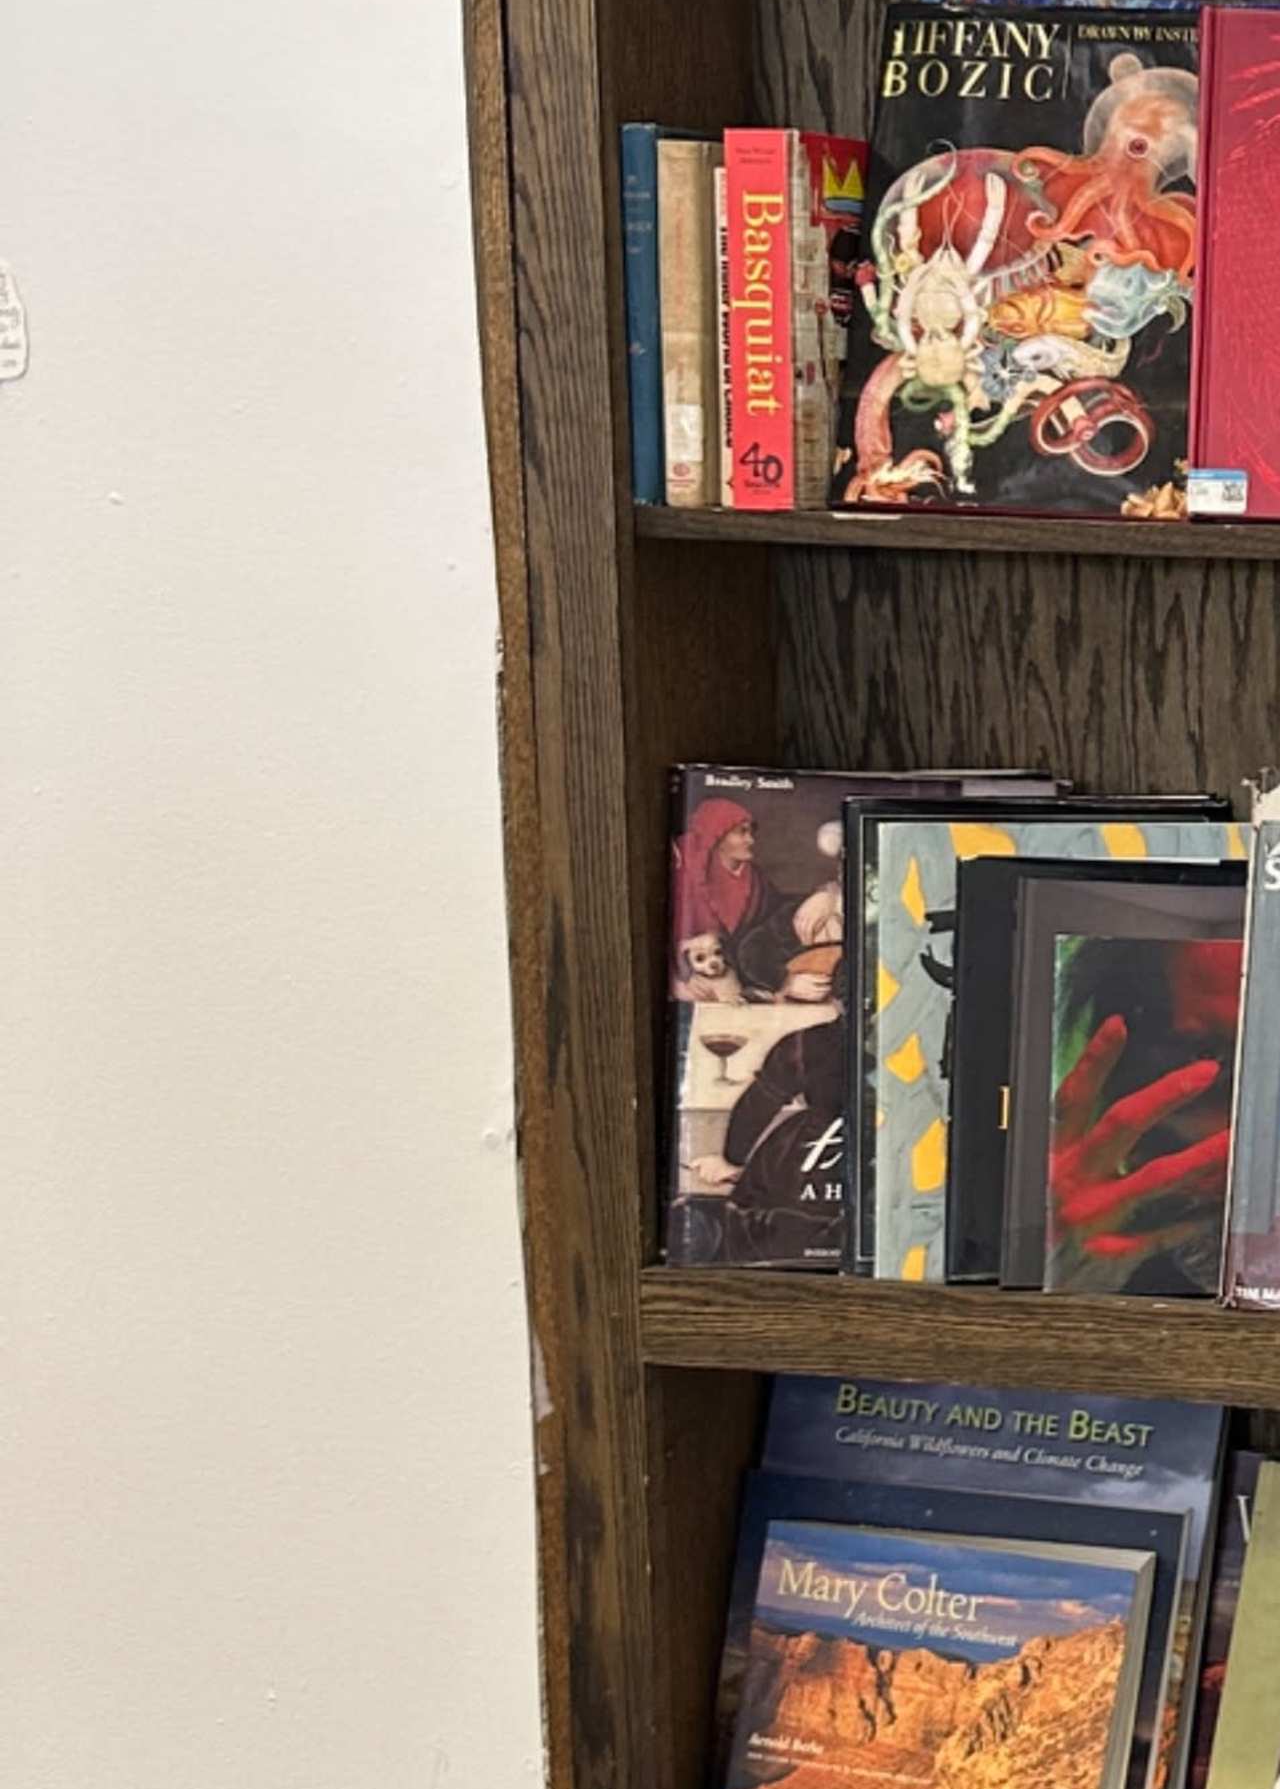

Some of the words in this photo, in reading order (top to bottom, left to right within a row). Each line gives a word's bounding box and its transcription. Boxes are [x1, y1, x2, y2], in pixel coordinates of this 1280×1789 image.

[891, 20, 1060, 60] TIFFANY
[882, 60, 1054, 101] BOZIC
[730, 189, 785, 417] Basquiat
[739, 441, 785, 485] 40
[836, 1383, 939, 1424] BEAUTY
[944, 1404, 1003, 1432] AND
[1010, 1410, 1060, 1437] THE
[1068, 1408, 1155, 1449] BEAST
[835, 1425, 904, 1452] California
[908, 1432, 989, 1463] Wildflowers
[1023, 1446, 1081, 1471] Climate
[1085, 1454, 1146, 1481] Change
[775, 1557, 869, 1620] Mary
[876, 1571, 986, 1624] Colter
